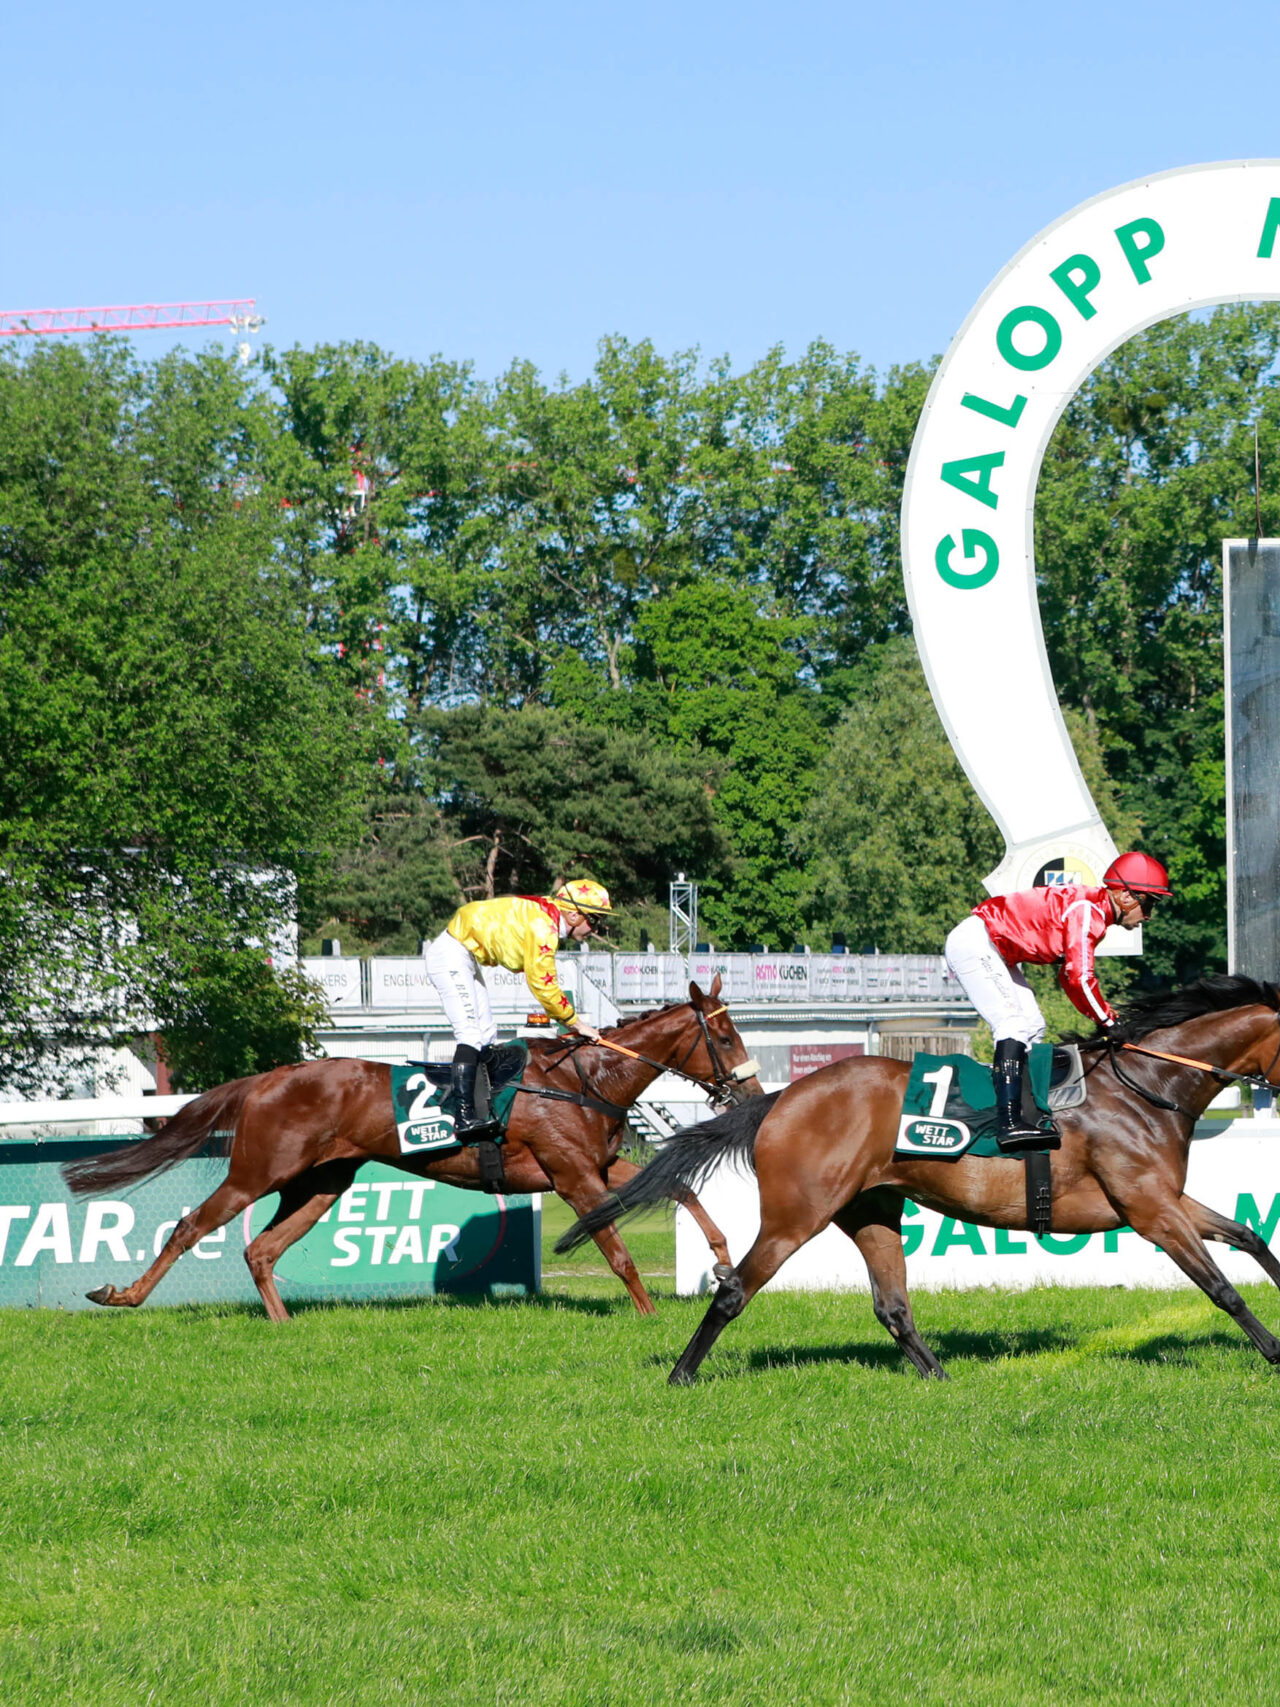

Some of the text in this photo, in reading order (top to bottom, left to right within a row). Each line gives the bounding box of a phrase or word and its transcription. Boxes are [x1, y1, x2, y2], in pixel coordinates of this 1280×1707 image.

[935, 217, 1165, 589] GALOPP
[406, 1073, 441, 1120] 2
[922, 1065, 953, 1118] 1
[411, 1123, 440, 1136] WETT
[420, 1129, 448, 1142] STAR
[915, 1124, 949, 1137] WETT
[922, 1135, 955, 1146] STAR
[318, 1181, 436, 1222] ETT
[330, 1224, 460, 1267] STAR
